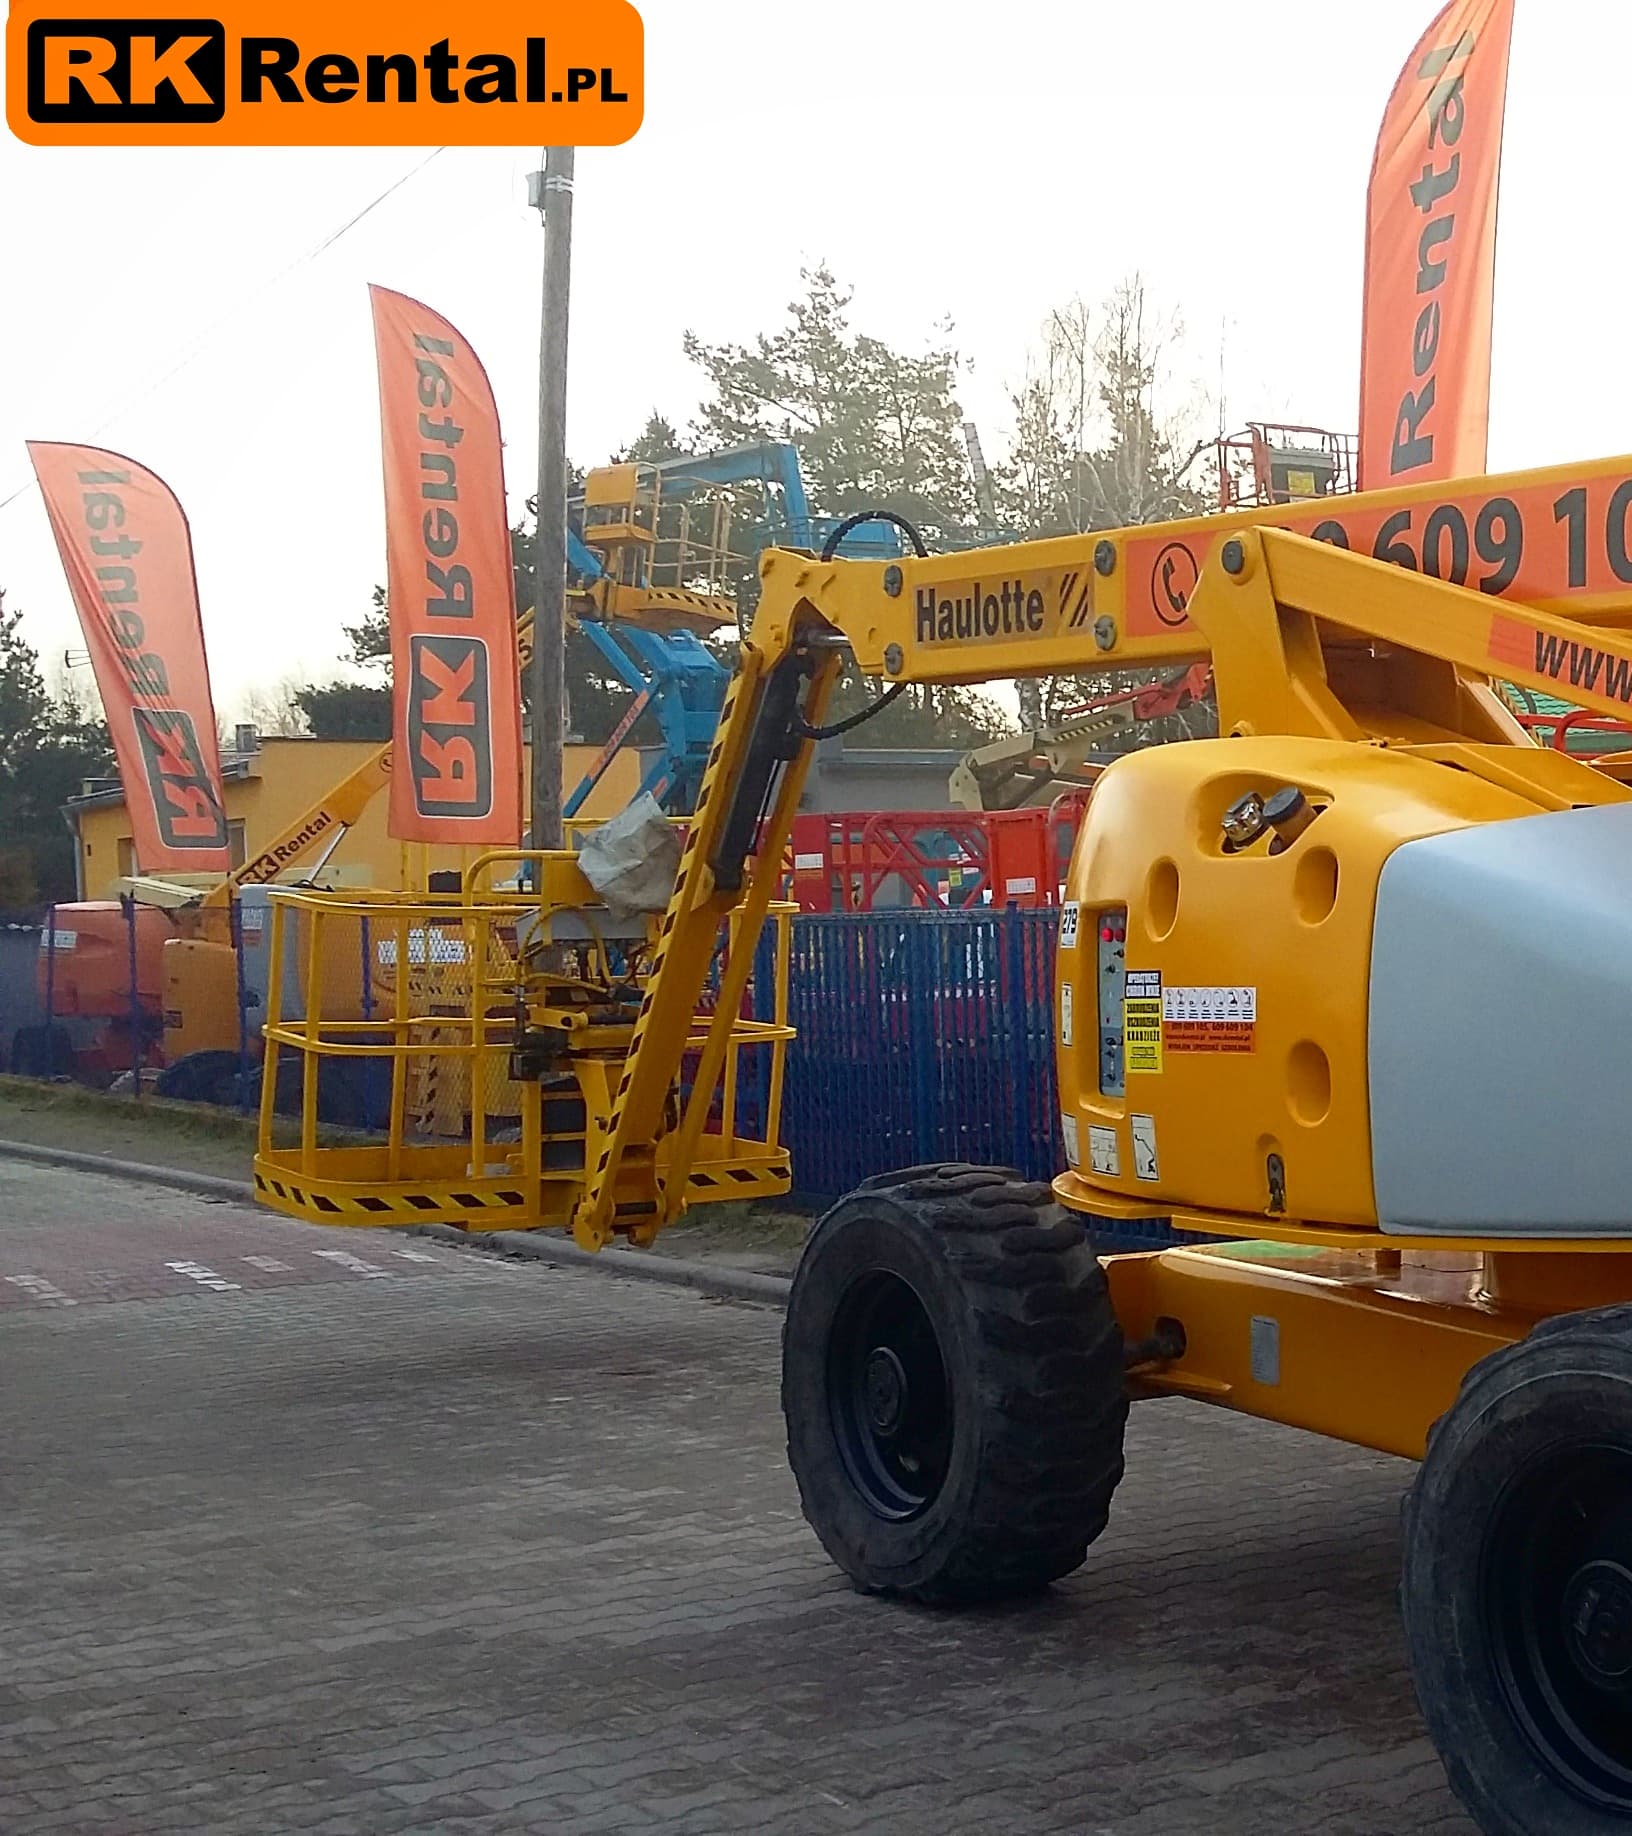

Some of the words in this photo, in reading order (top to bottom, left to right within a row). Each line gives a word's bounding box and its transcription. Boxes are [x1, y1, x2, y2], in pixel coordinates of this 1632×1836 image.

[1391, 30, 1476, 476] Rental
[916, 580, 1045, 643] Haulotte
[273, 810, 332, 862] Rental
